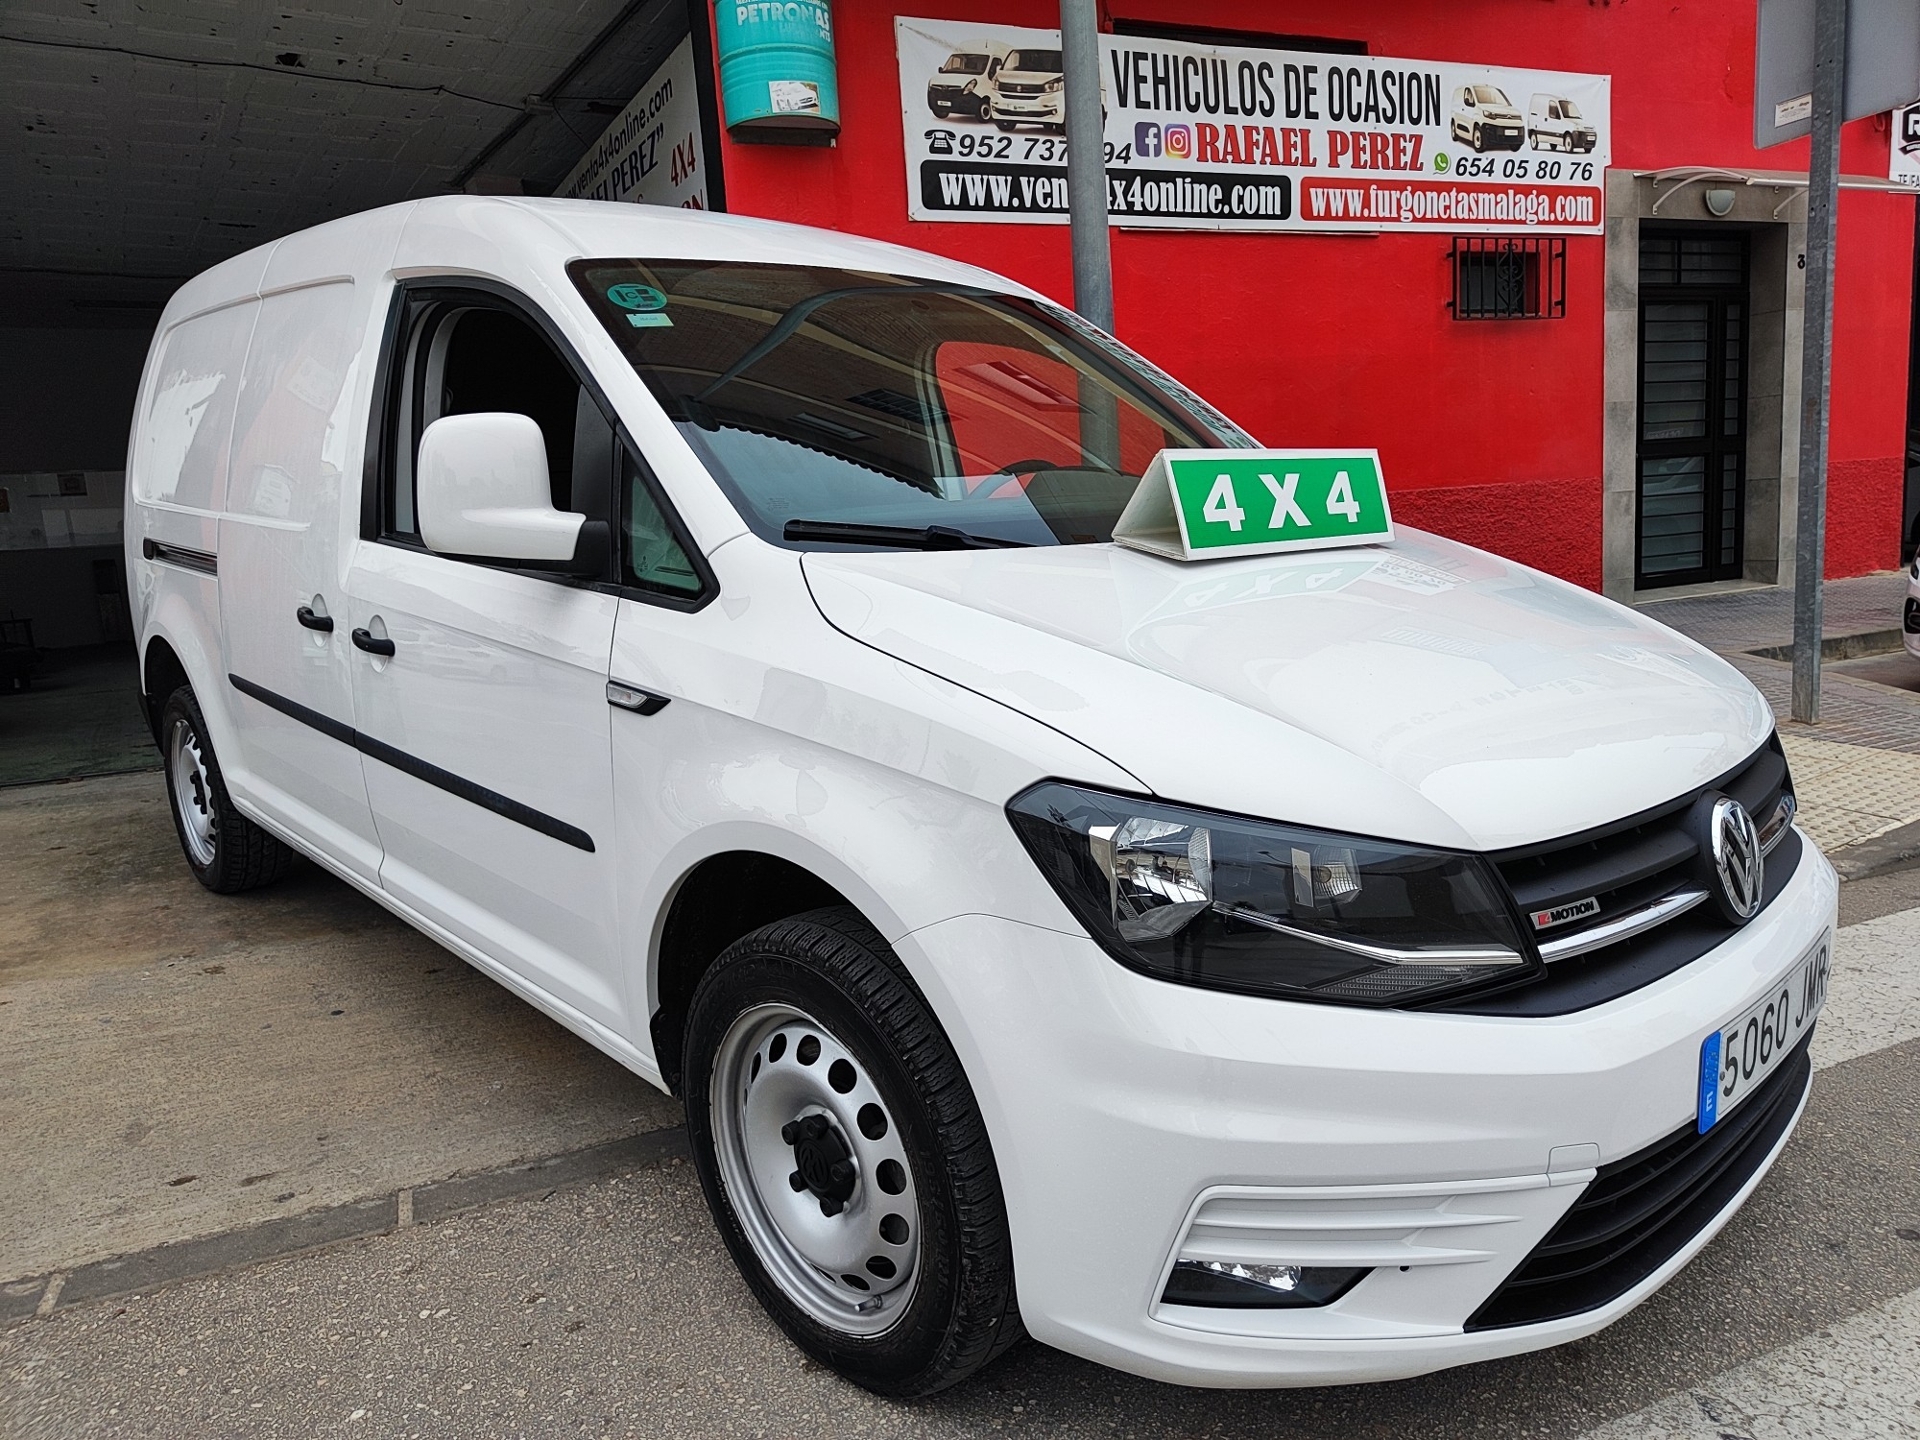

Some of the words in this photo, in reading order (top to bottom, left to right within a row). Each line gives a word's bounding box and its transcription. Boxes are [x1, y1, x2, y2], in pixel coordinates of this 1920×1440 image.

[737, 2, 830, 31] PETRONAS
[1111, 49, 1275, 118] VEHICULOS
[1283, 64, 1319, 120] DE
[1328, 66, 1441, 126] OCASION
[670, 131, 696, 187] 4X4
[958, 134, 1013, 159] 952
[1103, 141, 1132, 165] 94
[1195, 122, 1317, 167] RAFAEL
[1327, 130, 1424, 171] PEREZ
[1455, 157, 1495, 177] 654
[1503, 158, 1529, 179] 05
[1536, 160, 1562, 180] 80
[1569, 162, 1594, 181] 76
[939, 172, 1281, 215] www.venx4online.com
[1309, 184, 1594, 225] www.furgonetasmalaga.com
[1203, 474, 1246, 532] 4
[1258, 473, 1312, 529] X
[1325, 470, 1361, 523] 4
[1722, 988, 1789, 1097] 5060
[1795, 944, 1827, 1028] JMR
